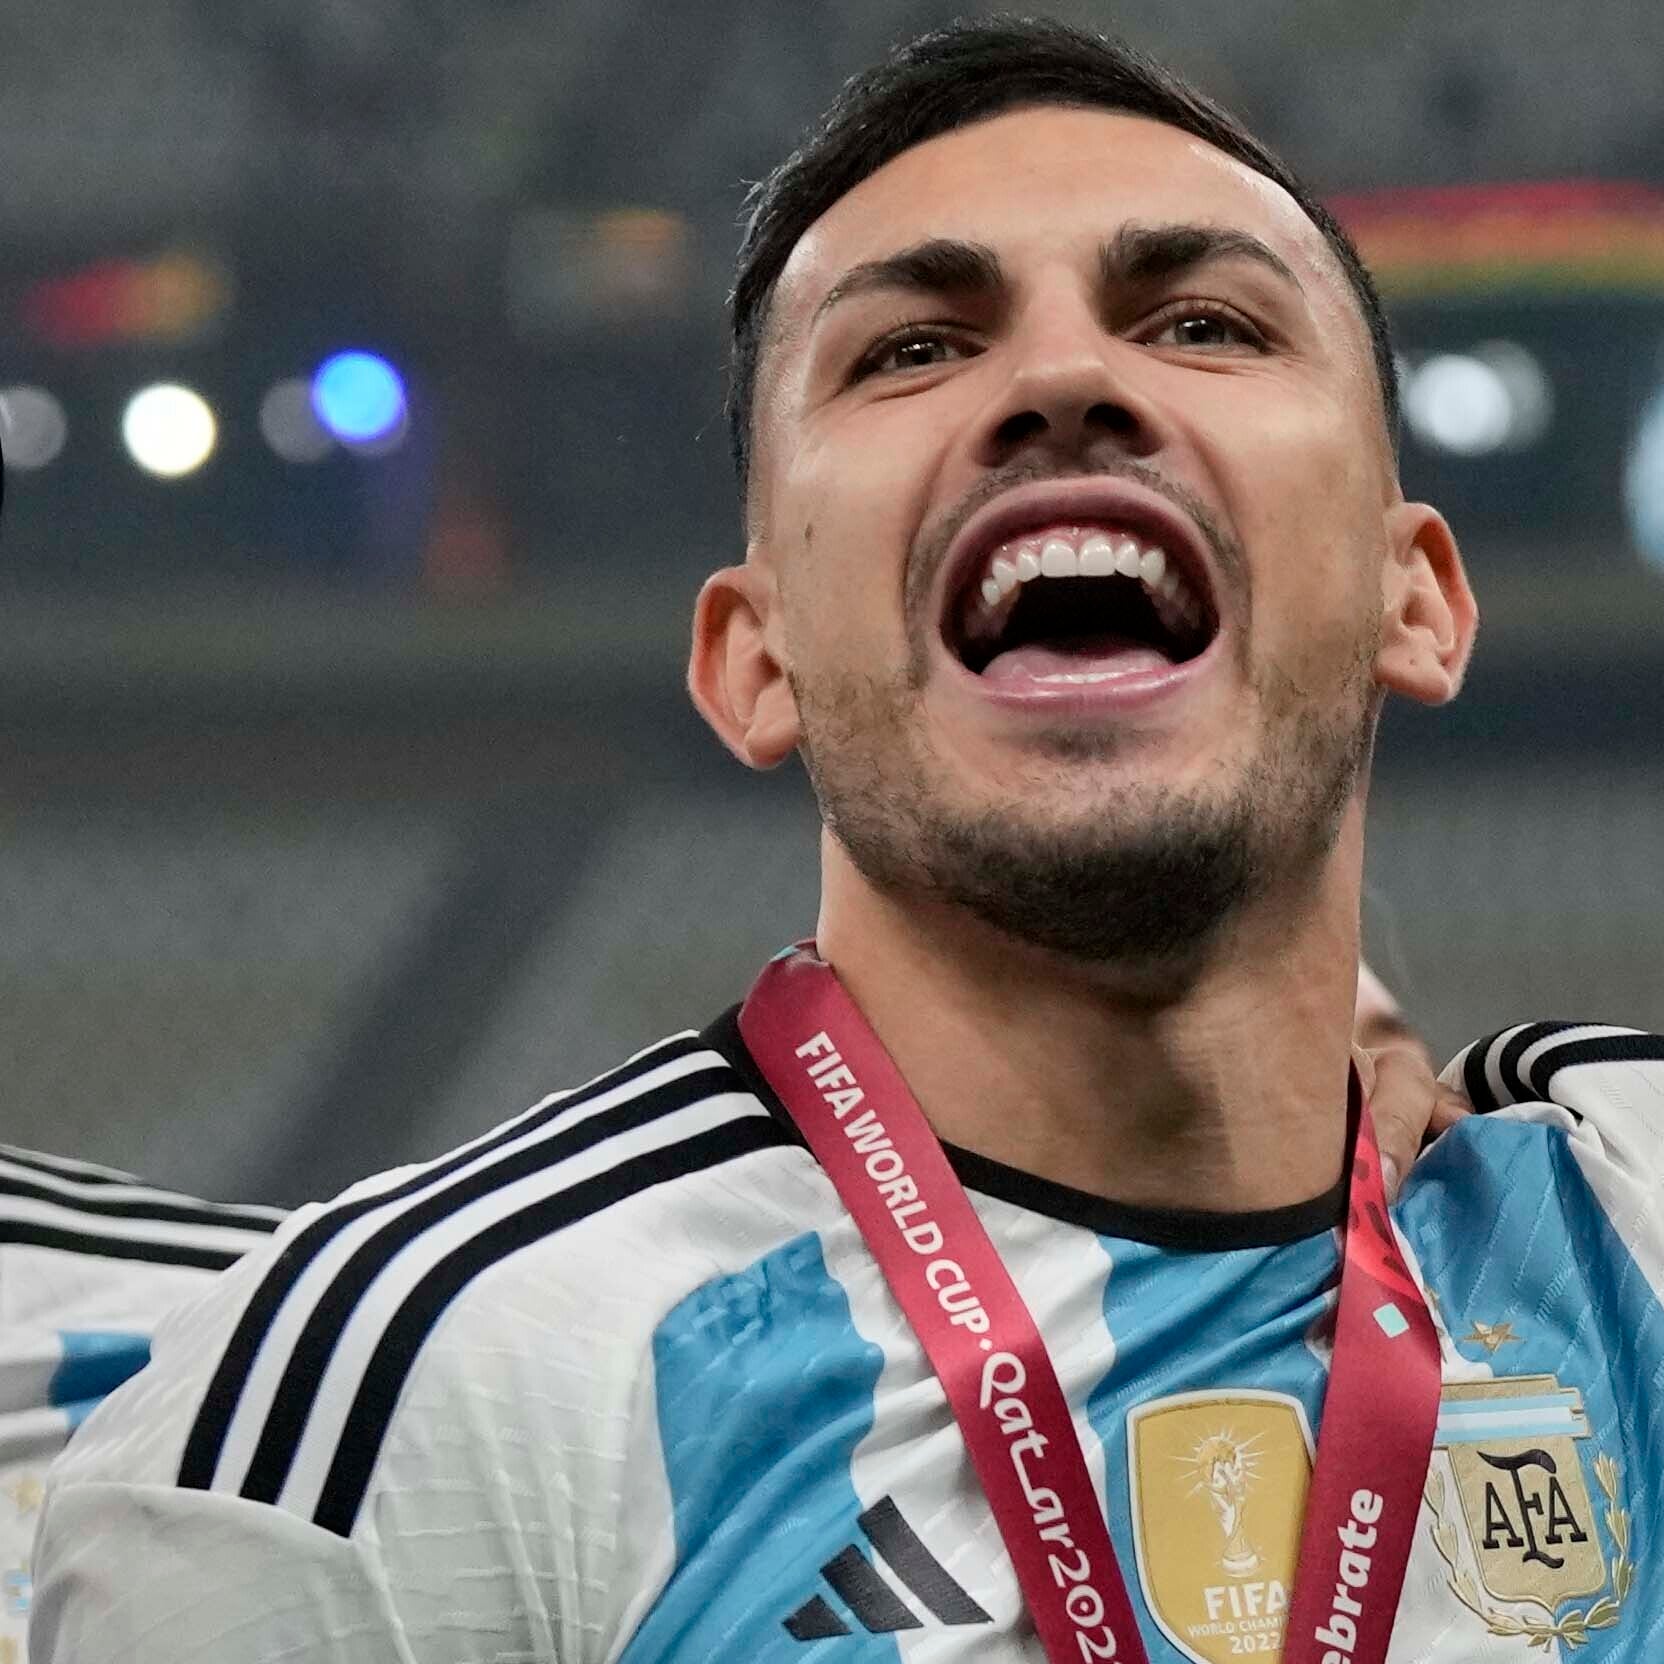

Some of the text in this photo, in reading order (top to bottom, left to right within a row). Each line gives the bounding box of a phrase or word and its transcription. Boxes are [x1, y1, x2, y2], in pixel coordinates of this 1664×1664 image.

[795, 1031, 865, 1119] FIFA
[844, 1109, 944, 1255] WORLD
[925, 1259, 991, 1334] CUP
[1476, 1449, 1588, 1569] AFA
[1203, 1580, 1287, 1621] FIFA
[1186, 1622, 1234, 1638] WORLD
[1229, 1632, 1280, 1655] 2022
